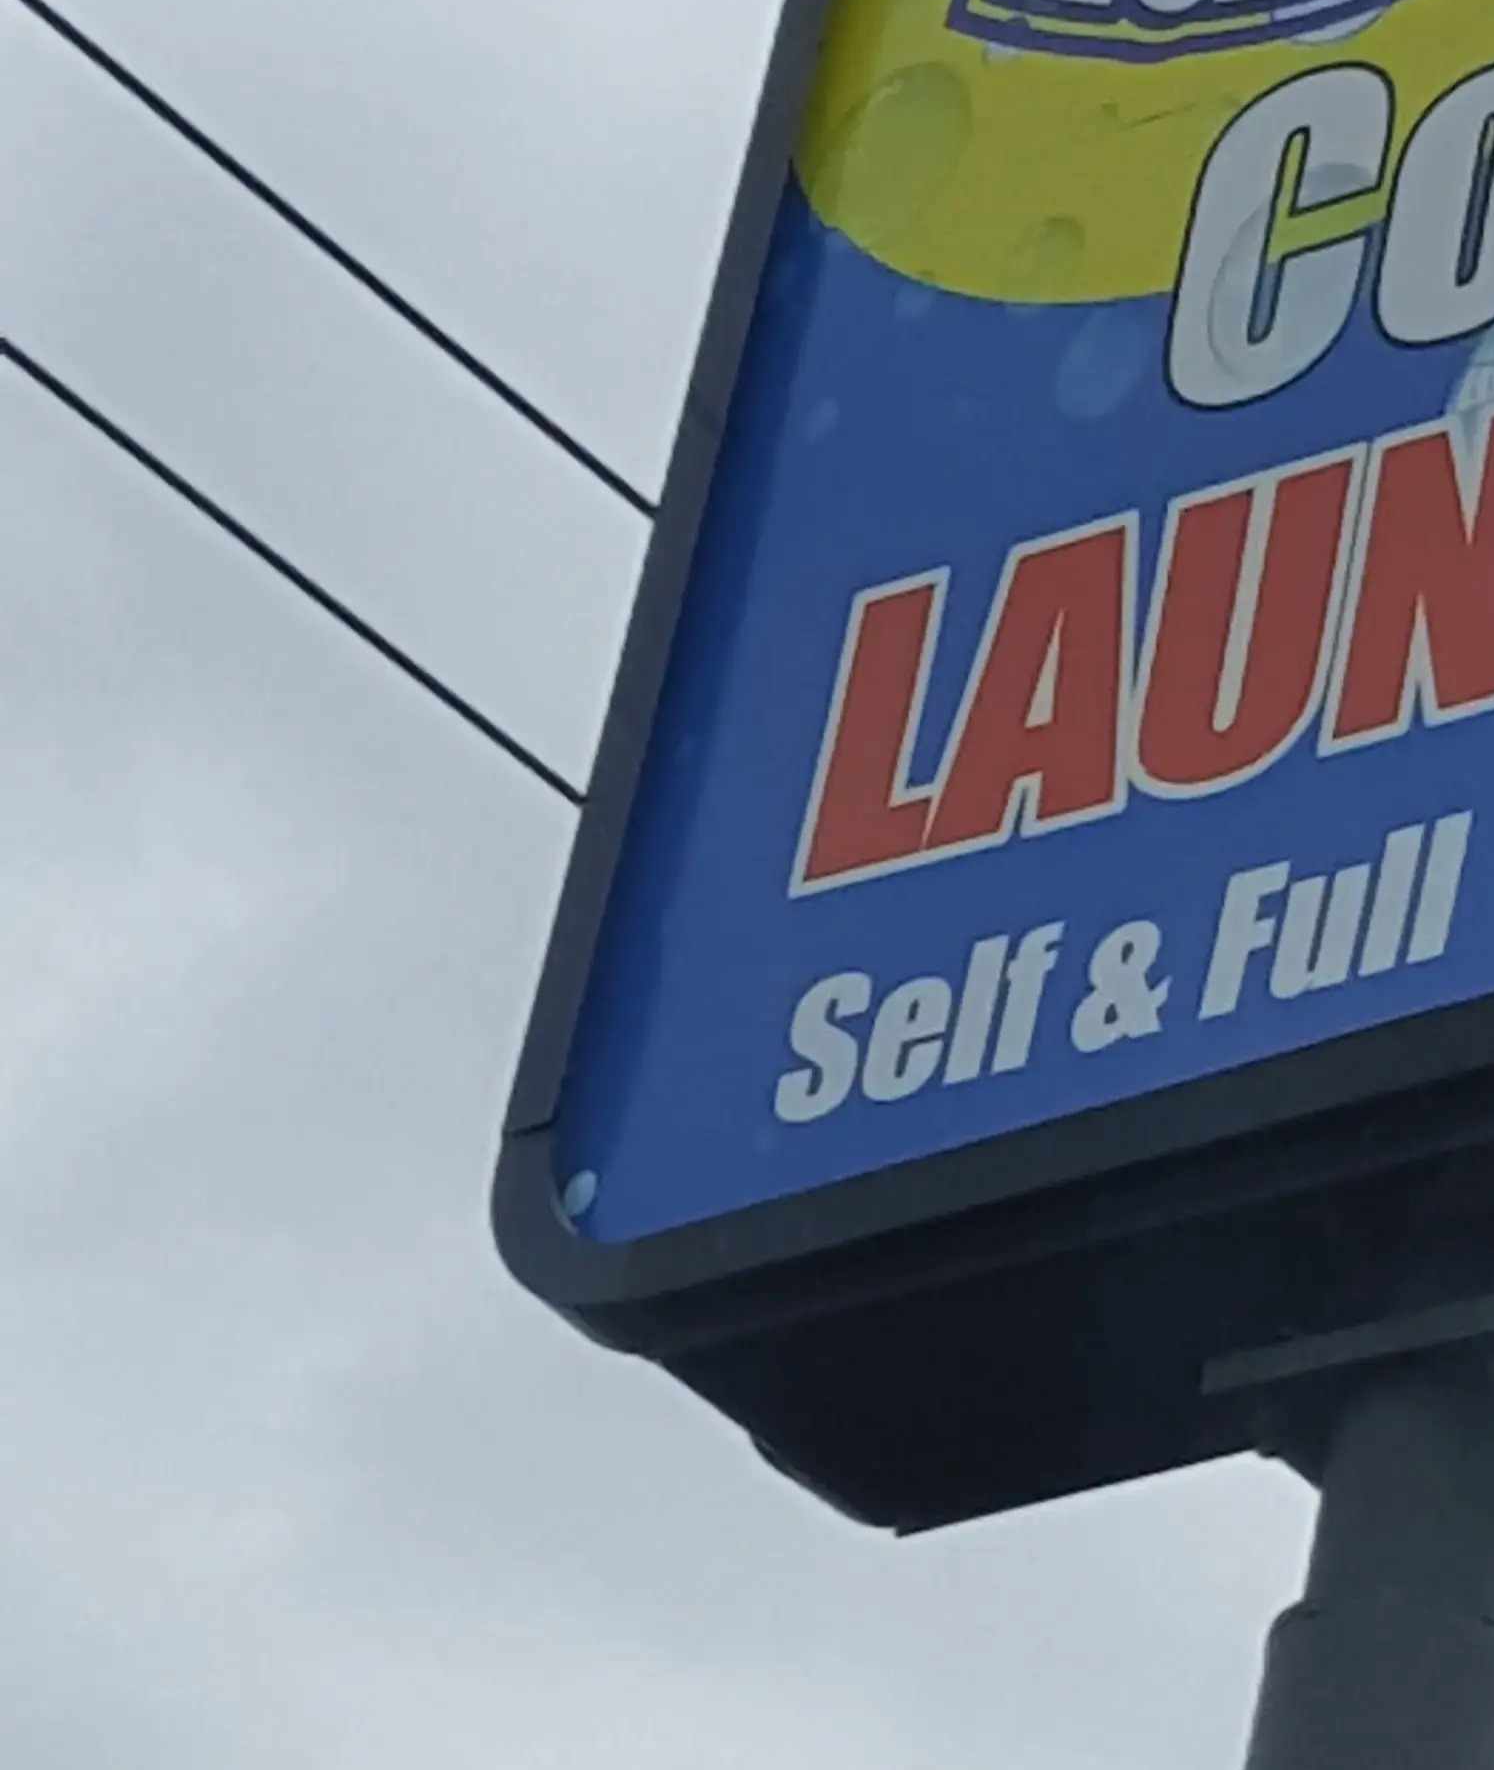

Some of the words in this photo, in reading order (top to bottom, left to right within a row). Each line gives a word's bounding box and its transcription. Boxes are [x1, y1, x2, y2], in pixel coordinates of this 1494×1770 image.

[773, 921, 1064, 1123] Self
[1069, 919, 1172, 1053] &
[1197, 811, 1473, 1019] Full
